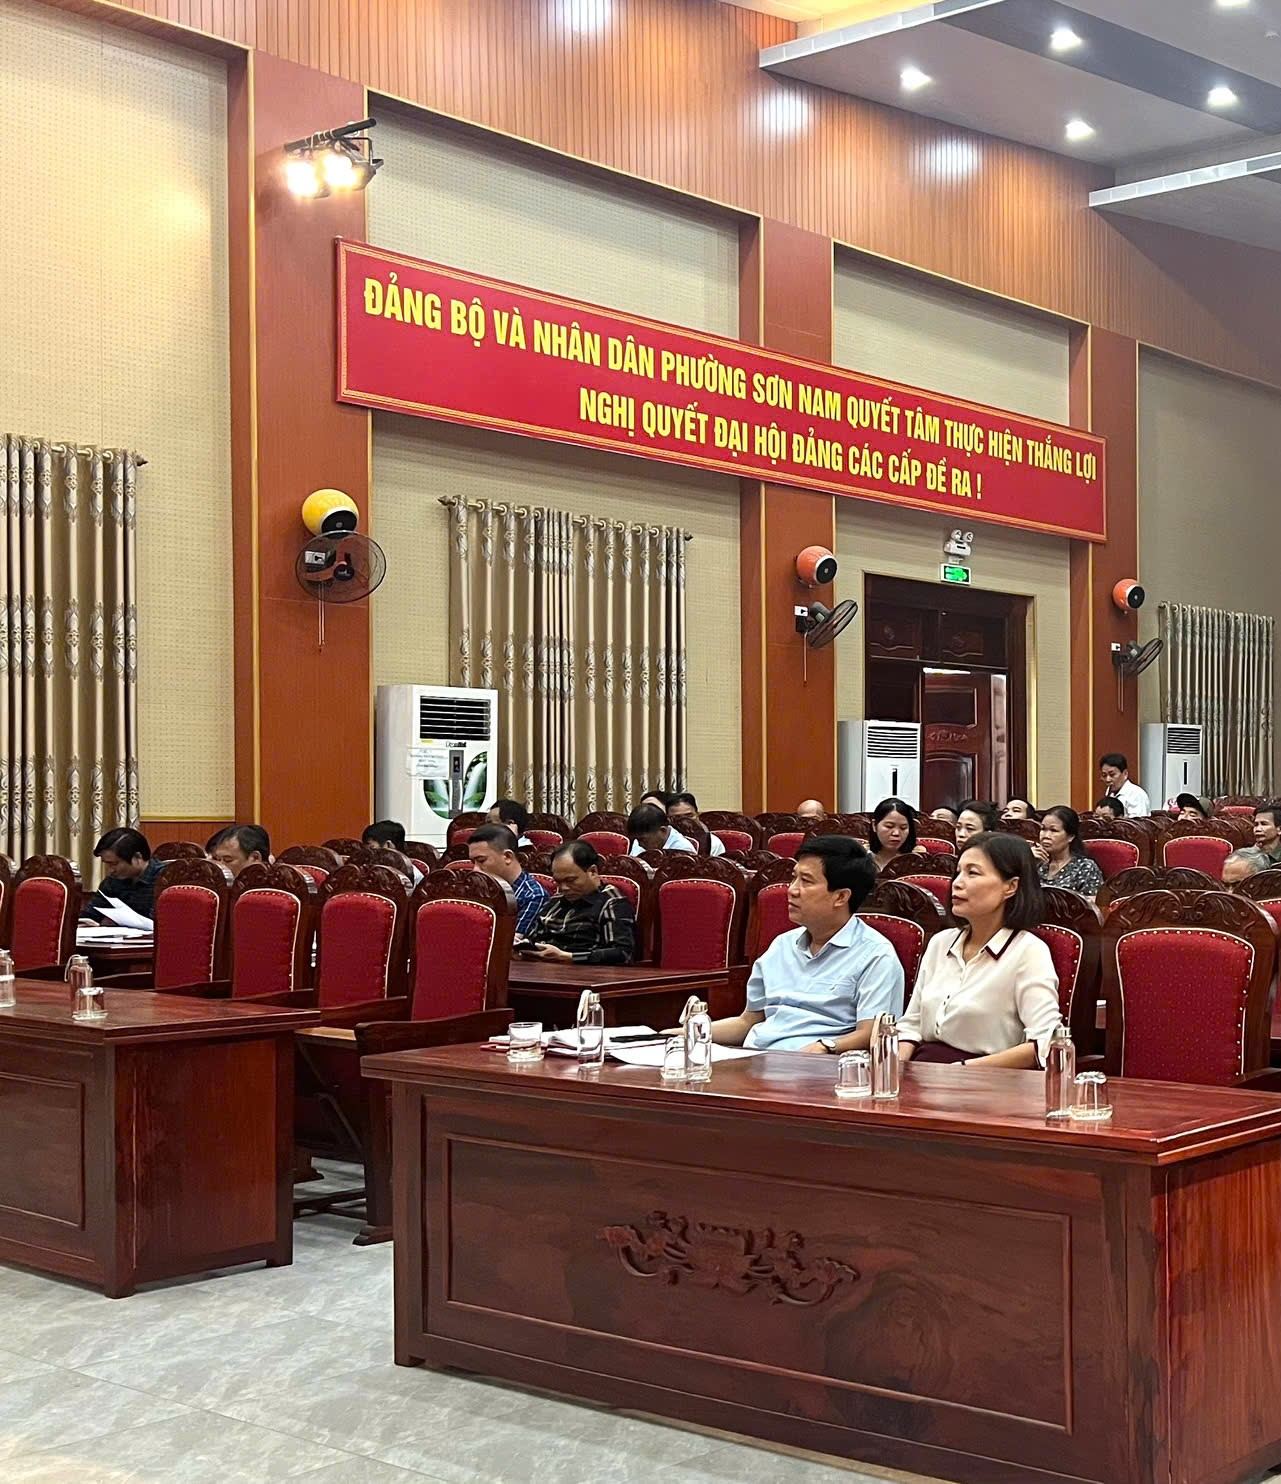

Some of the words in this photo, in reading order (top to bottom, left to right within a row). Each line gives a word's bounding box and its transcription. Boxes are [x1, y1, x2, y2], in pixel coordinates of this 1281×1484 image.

[364, 272, 442, 330] ĐẢNG
[451, 297, 485, 347] BỘ
[493, 307, 526, 350] VÀ
[534, 320, 601, 366] NHÂN
[608, 336, 655, 379] DÂN
[661, 351, 748, 400] PHƯỜNG
[752, 373, 793, 410] SƠN
[798, 384, 841, 421] NAM
[847, 396, 900, 433] QUYẾT
[904, 406, 940, 445] TÂM
[944, 419, 984, 459] THỰC
[988, 428, 1023, 469] HIỆN
[1027, 436, 1072, 475] THẮNG
[1076, 452, 1097, 485] LỢI
[580, 387, 635, 437] NGHỊ
[642, 401, 708, 446] QUYẾT
[714, 417, 748, 459] ĐẠI
[754, 422, 787, 465] HỘI
[792, 427, 843, 475] ĐẢNG
[848, 442, 883, 480] CÁC
[888, 446, 922, 486] CẤP
[926, 456, 948, 493] ĐỀ
[951, 469, 972, 498] RA
[977, 473, 983, 499] !
